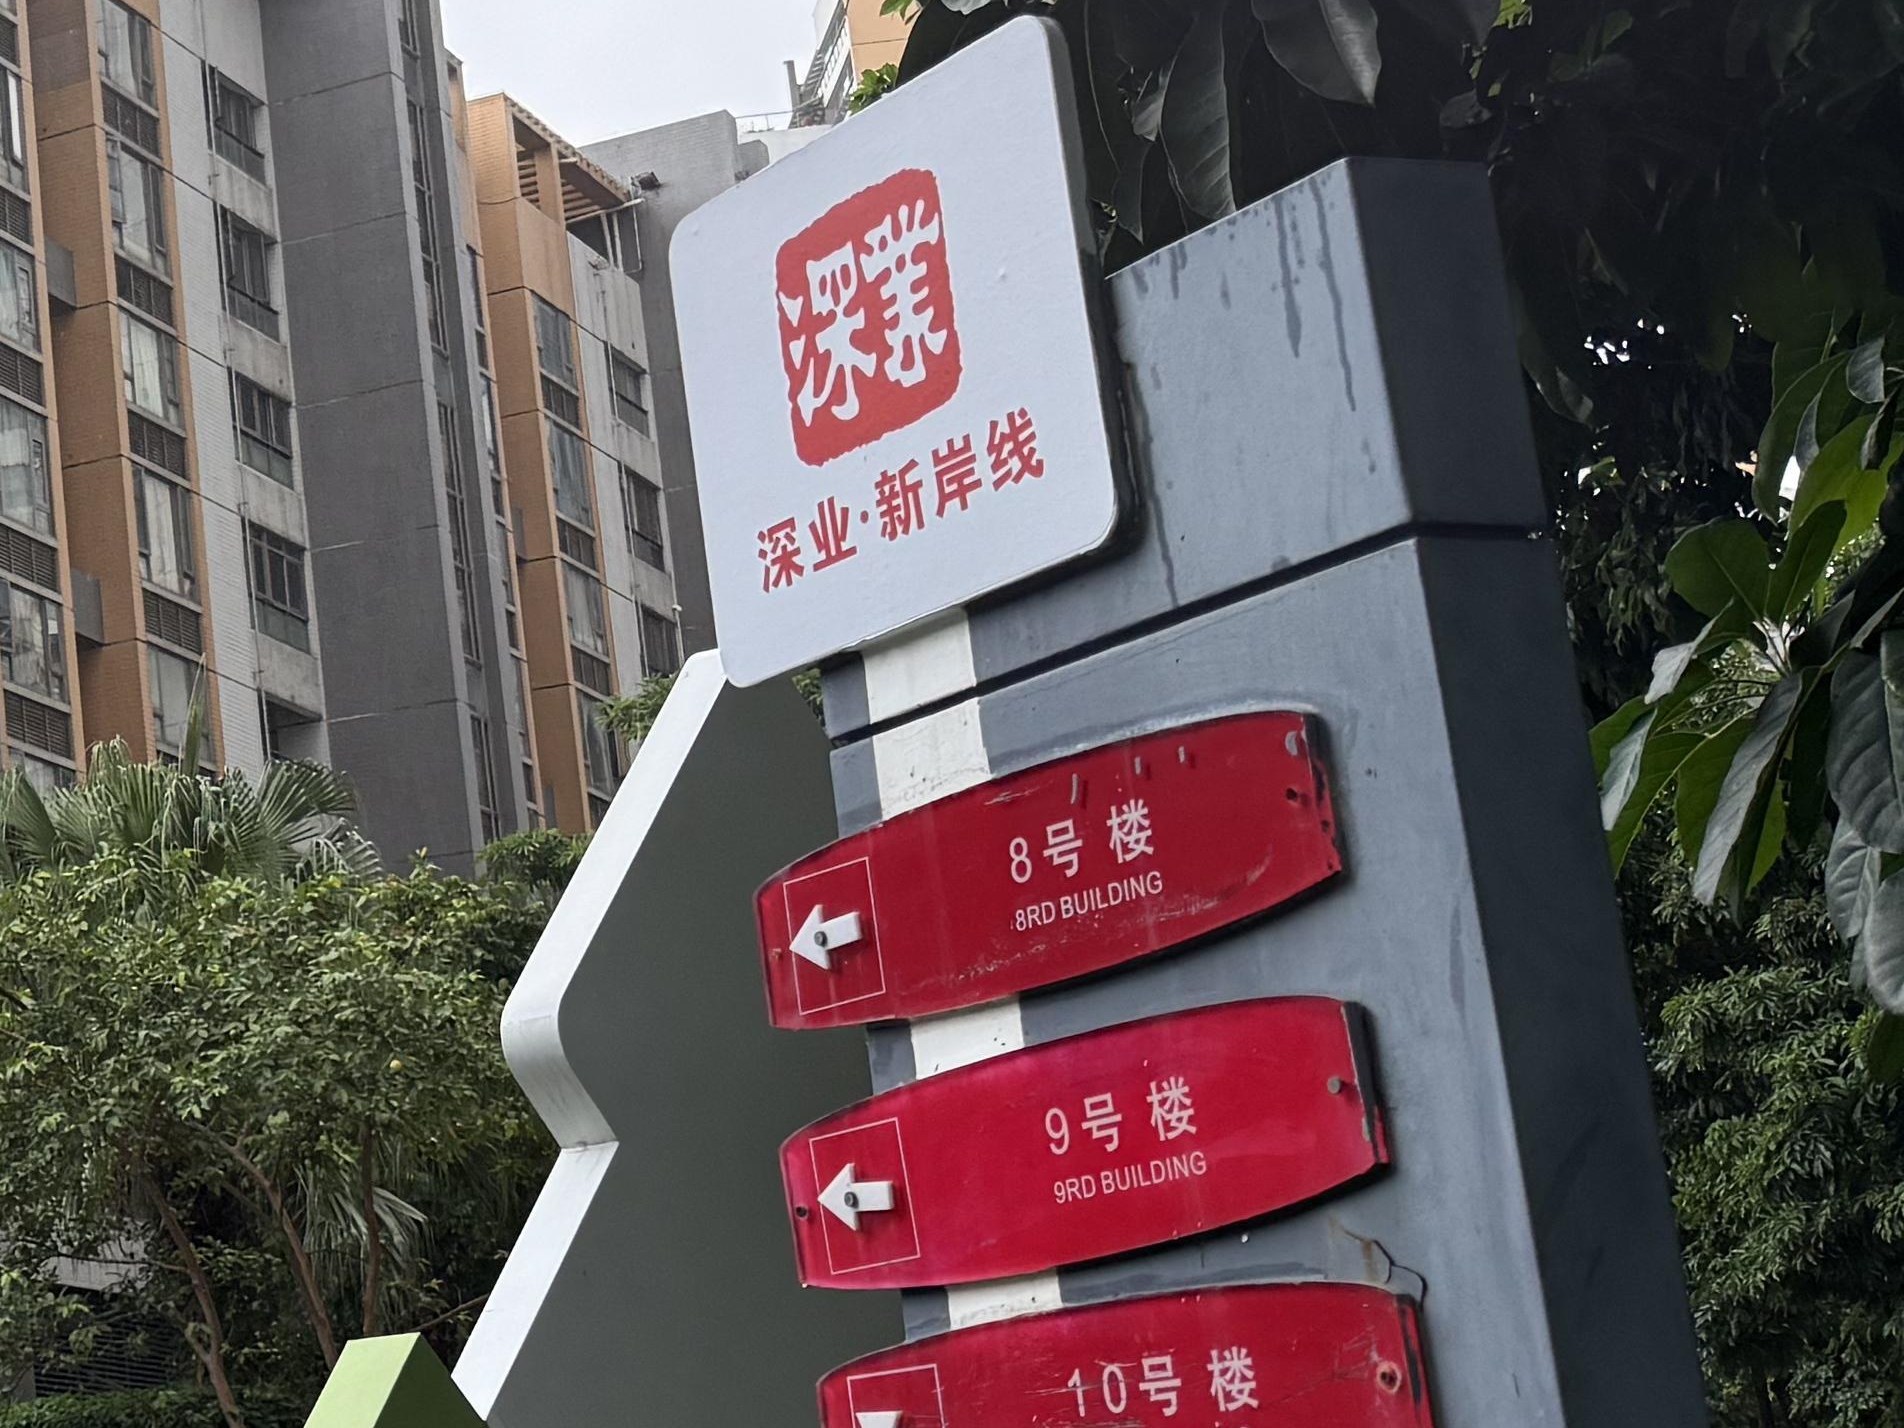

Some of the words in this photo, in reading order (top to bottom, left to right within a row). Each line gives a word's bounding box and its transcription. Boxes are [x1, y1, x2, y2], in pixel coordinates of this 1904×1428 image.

[757, 408, 1045, 593] 深业·新岸线
[1015, 901, 1056, 931] 8RD
[1060, 871, 1163, 919] BUILDING
[1054, 1175, 1096, 1204] 9RD
[1100, 1151, 1207, 1194] BUILDING
